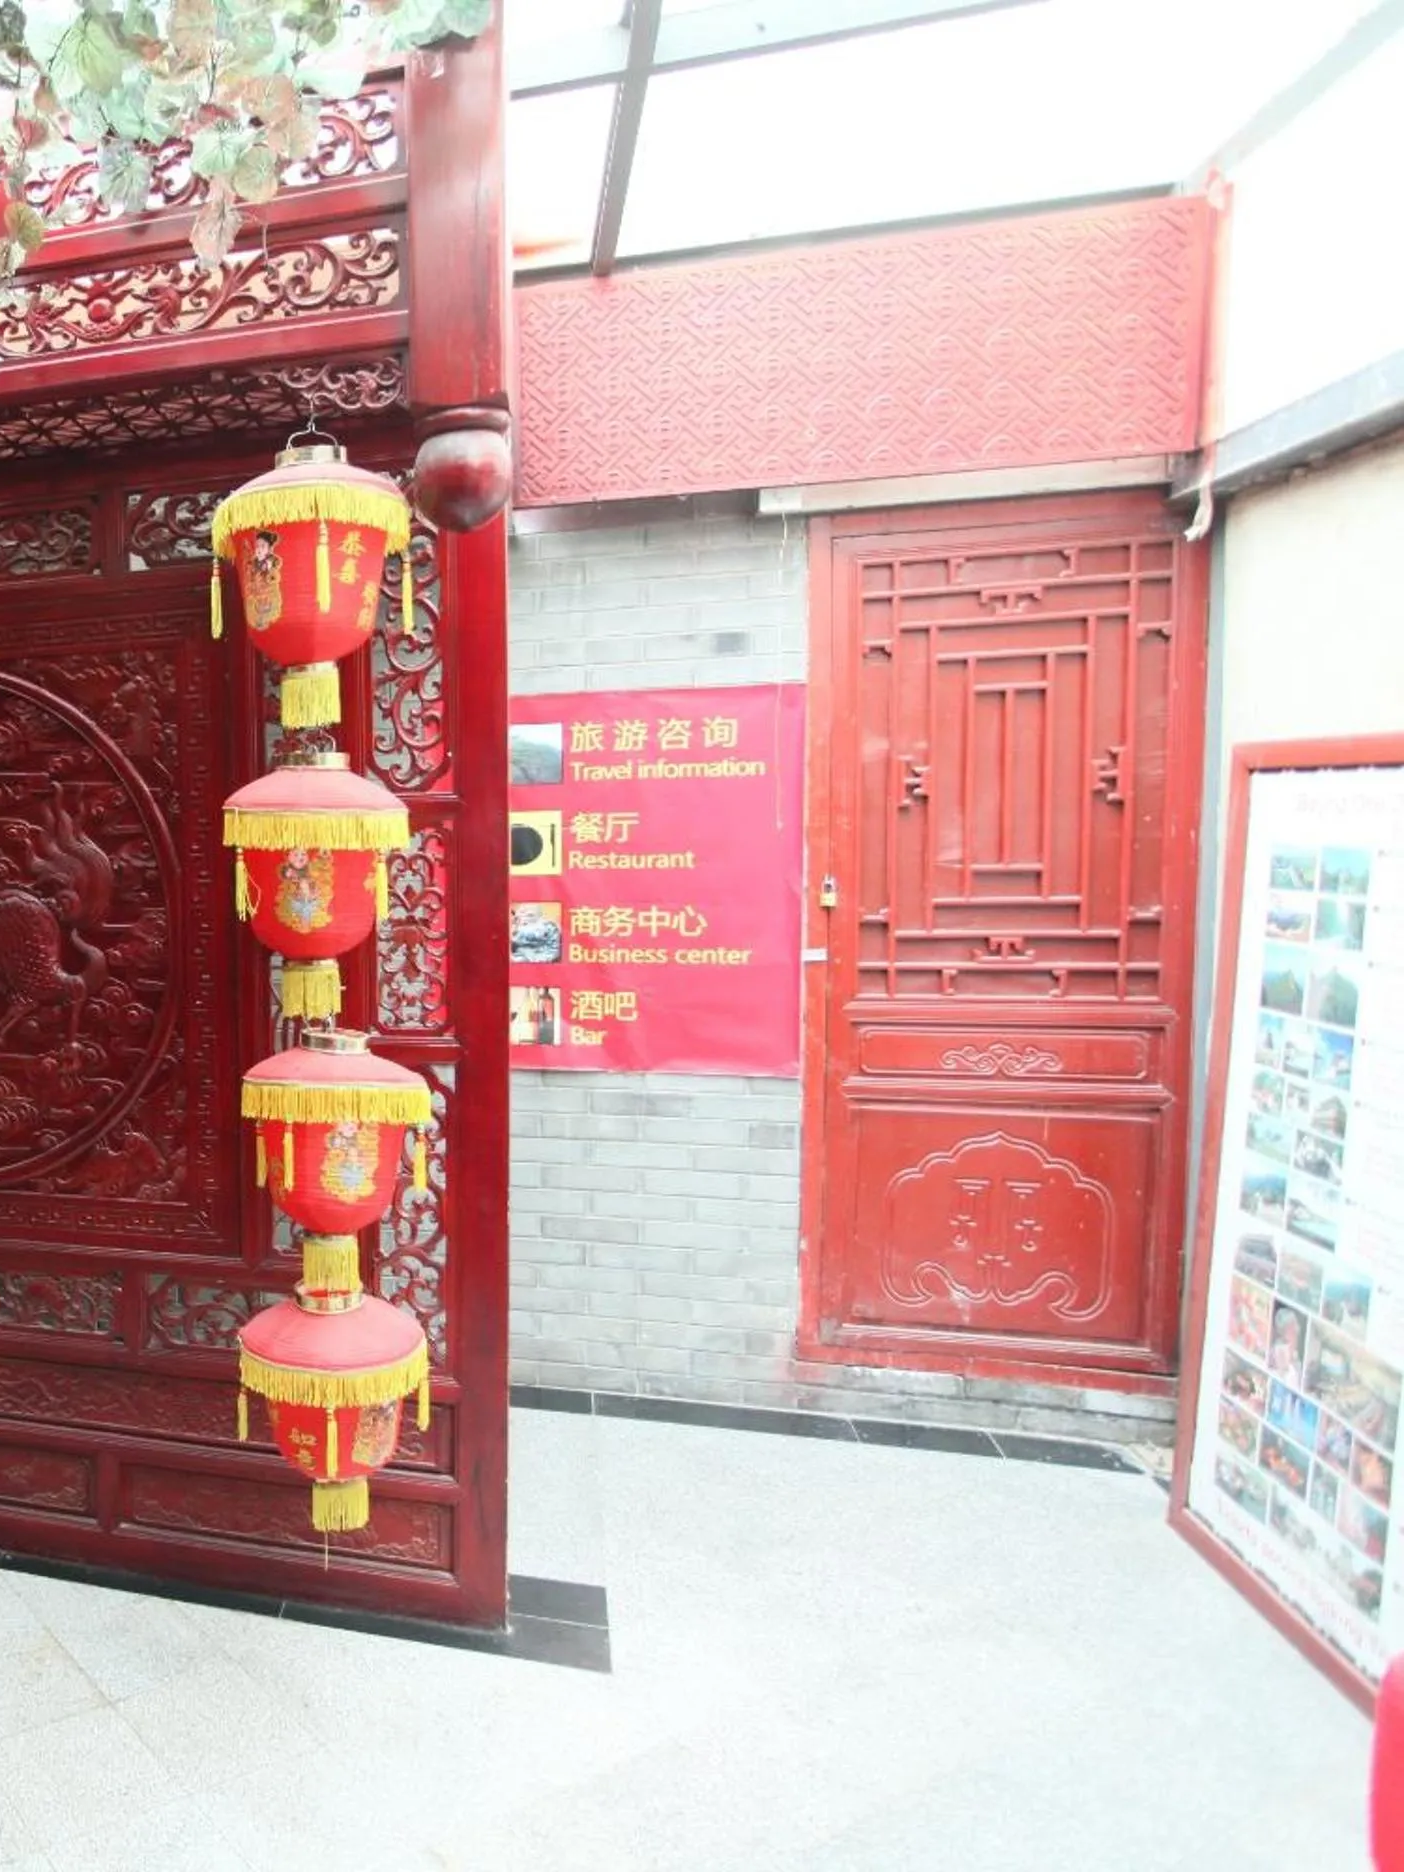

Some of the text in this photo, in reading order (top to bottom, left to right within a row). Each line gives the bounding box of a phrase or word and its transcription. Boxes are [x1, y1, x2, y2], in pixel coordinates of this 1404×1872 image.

[570, 717, 738, 753] 旅游咨询
[570, 758, 765, 781] Travel information
[569, 812, 639, 844] 餐厅
[569, 851, 695, 869] Restaurant
[570, 906, 708, 938] 商务中心
[569, 945, 752, 965] Business center
[570, 991, 638, 1022] 酒吧
[570, 1026, 607, 1046] Bar
